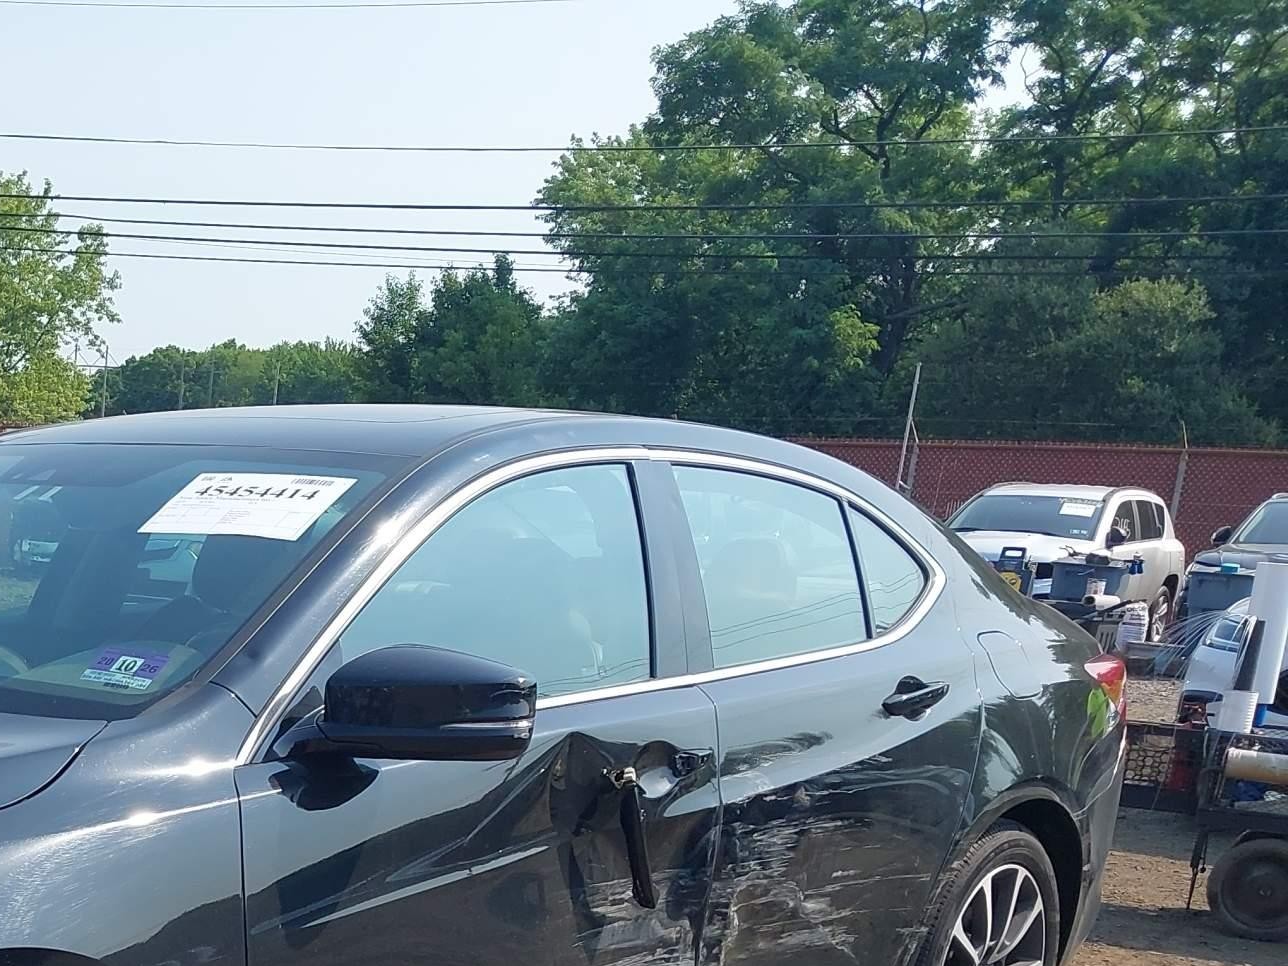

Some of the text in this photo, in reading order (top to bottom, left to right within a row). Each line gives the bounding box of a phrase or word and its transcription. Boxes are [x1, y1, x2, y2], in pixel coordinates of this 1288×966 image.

[195, 485, 321, 501] 45454414
[115, 659, 138, 672] 10
[140, 663, 159, 674] 26
